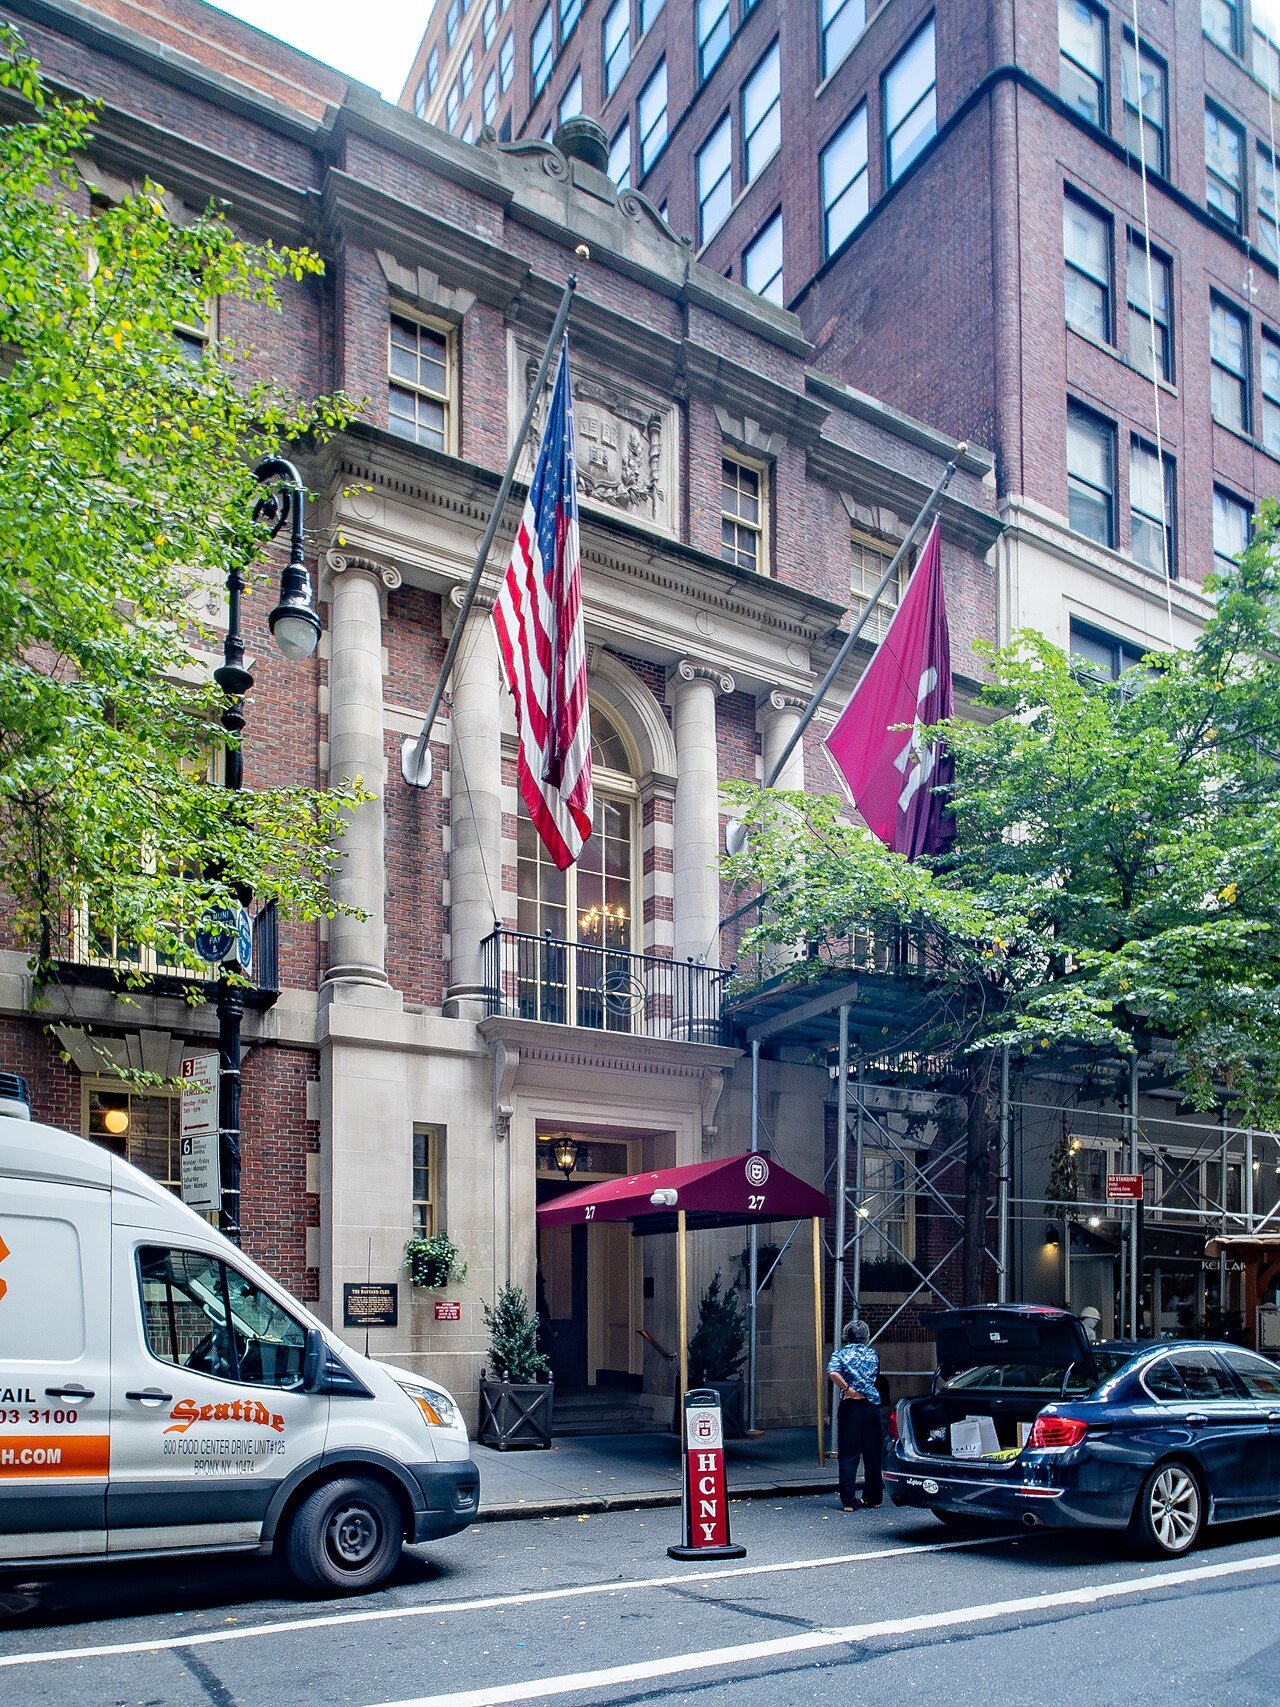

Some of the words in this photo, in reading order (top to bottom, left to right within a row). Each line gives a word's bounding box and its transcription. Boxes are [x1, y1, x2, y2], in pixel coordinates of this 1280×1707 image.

[185, 1061, 192, 1076] 3
[183, 1139, 190, 1154] 6
[748, 1195, 766, 1210] 27
[584, 1205, 596, 1220] 27
[0, 1388, 36, 1403] AIL
[28, 1409, 78, 1424] 3100
[163, 1399, 285, 1434] Seatide
[163, 1440, 176, 1455] 800
[178, 1440, 199, 1455] FOOD
[200, 1440, 230, 1455] CENTER
[231, 1440, 253, 1455] DRIVE
[0, 1448, 62, 1465] H.COM
[697, 1453, 717, 1541] HCNY
